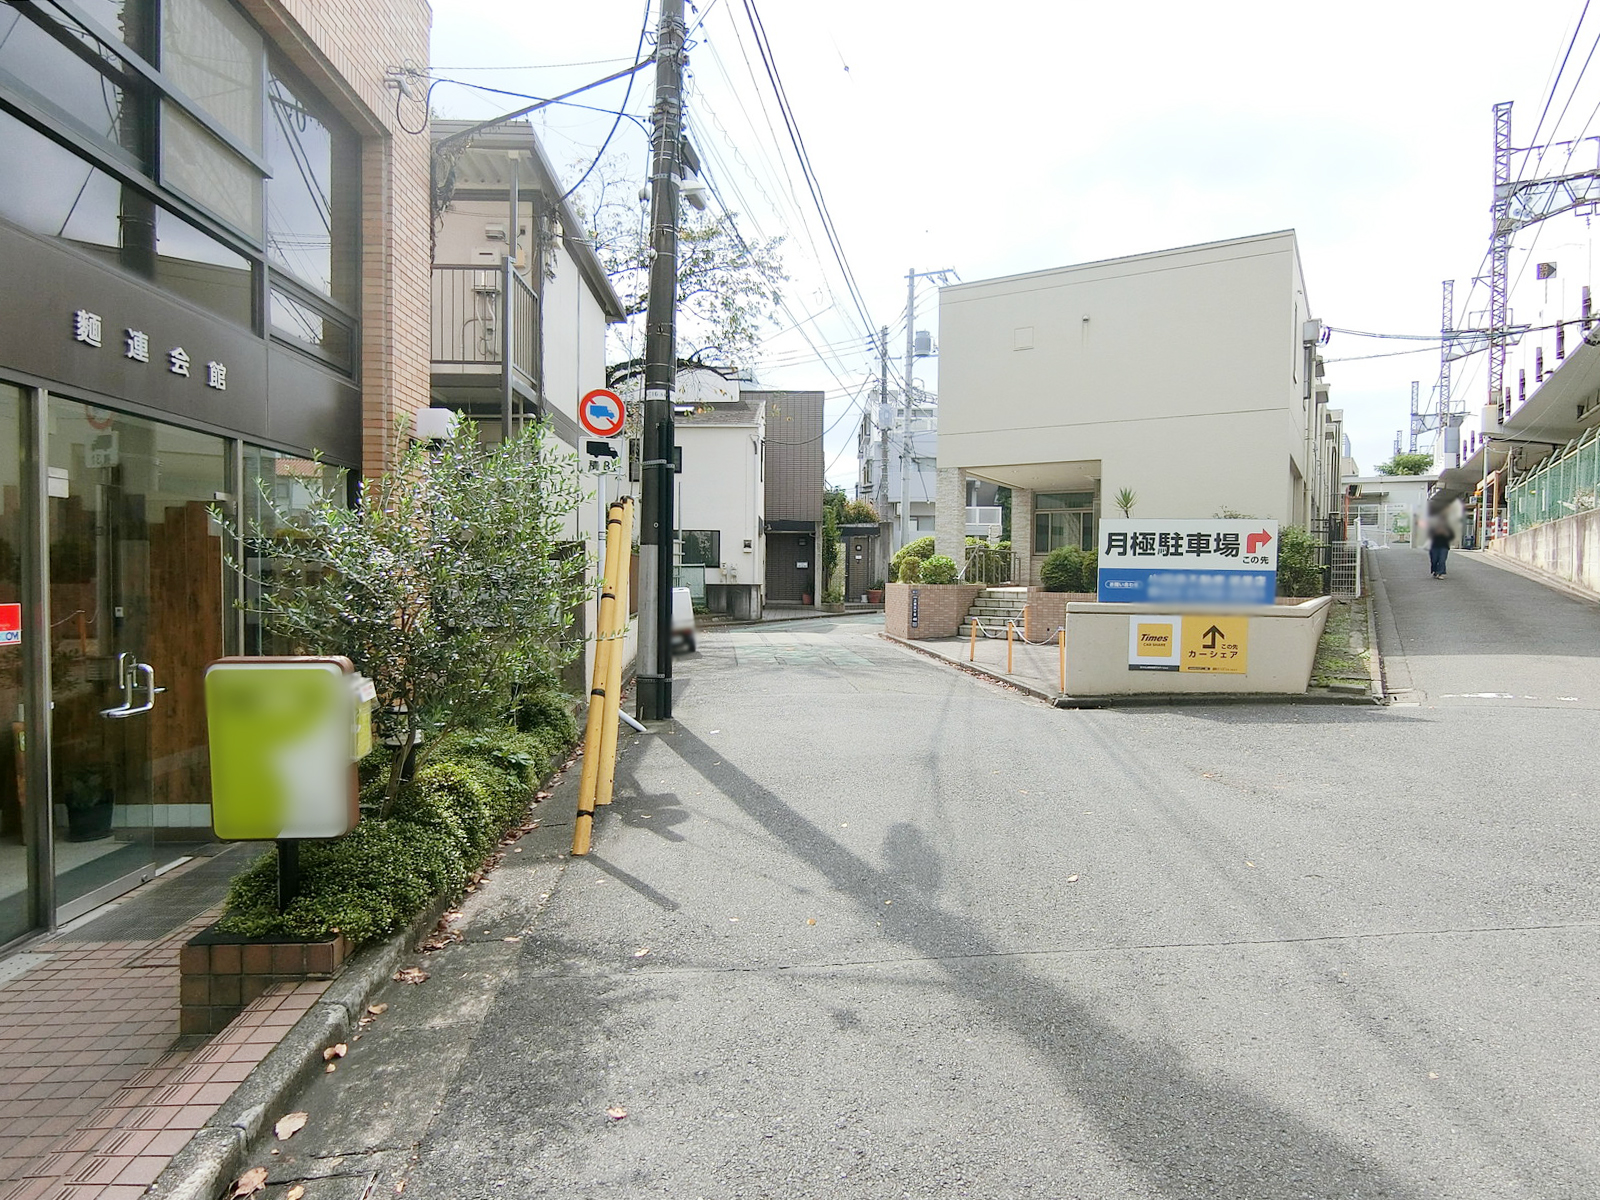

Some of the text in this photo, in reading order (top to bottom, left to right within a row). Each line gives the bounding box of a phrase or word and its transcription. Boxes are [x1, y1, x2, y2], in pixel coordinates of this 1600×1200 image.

[1104, 531, 1241, 558] 月極駐車場
[1242, 556, 1269, 565] この先
[1140, 633, 1169, 642] Times
[1188, 650, 1238, 659] カーシェア
